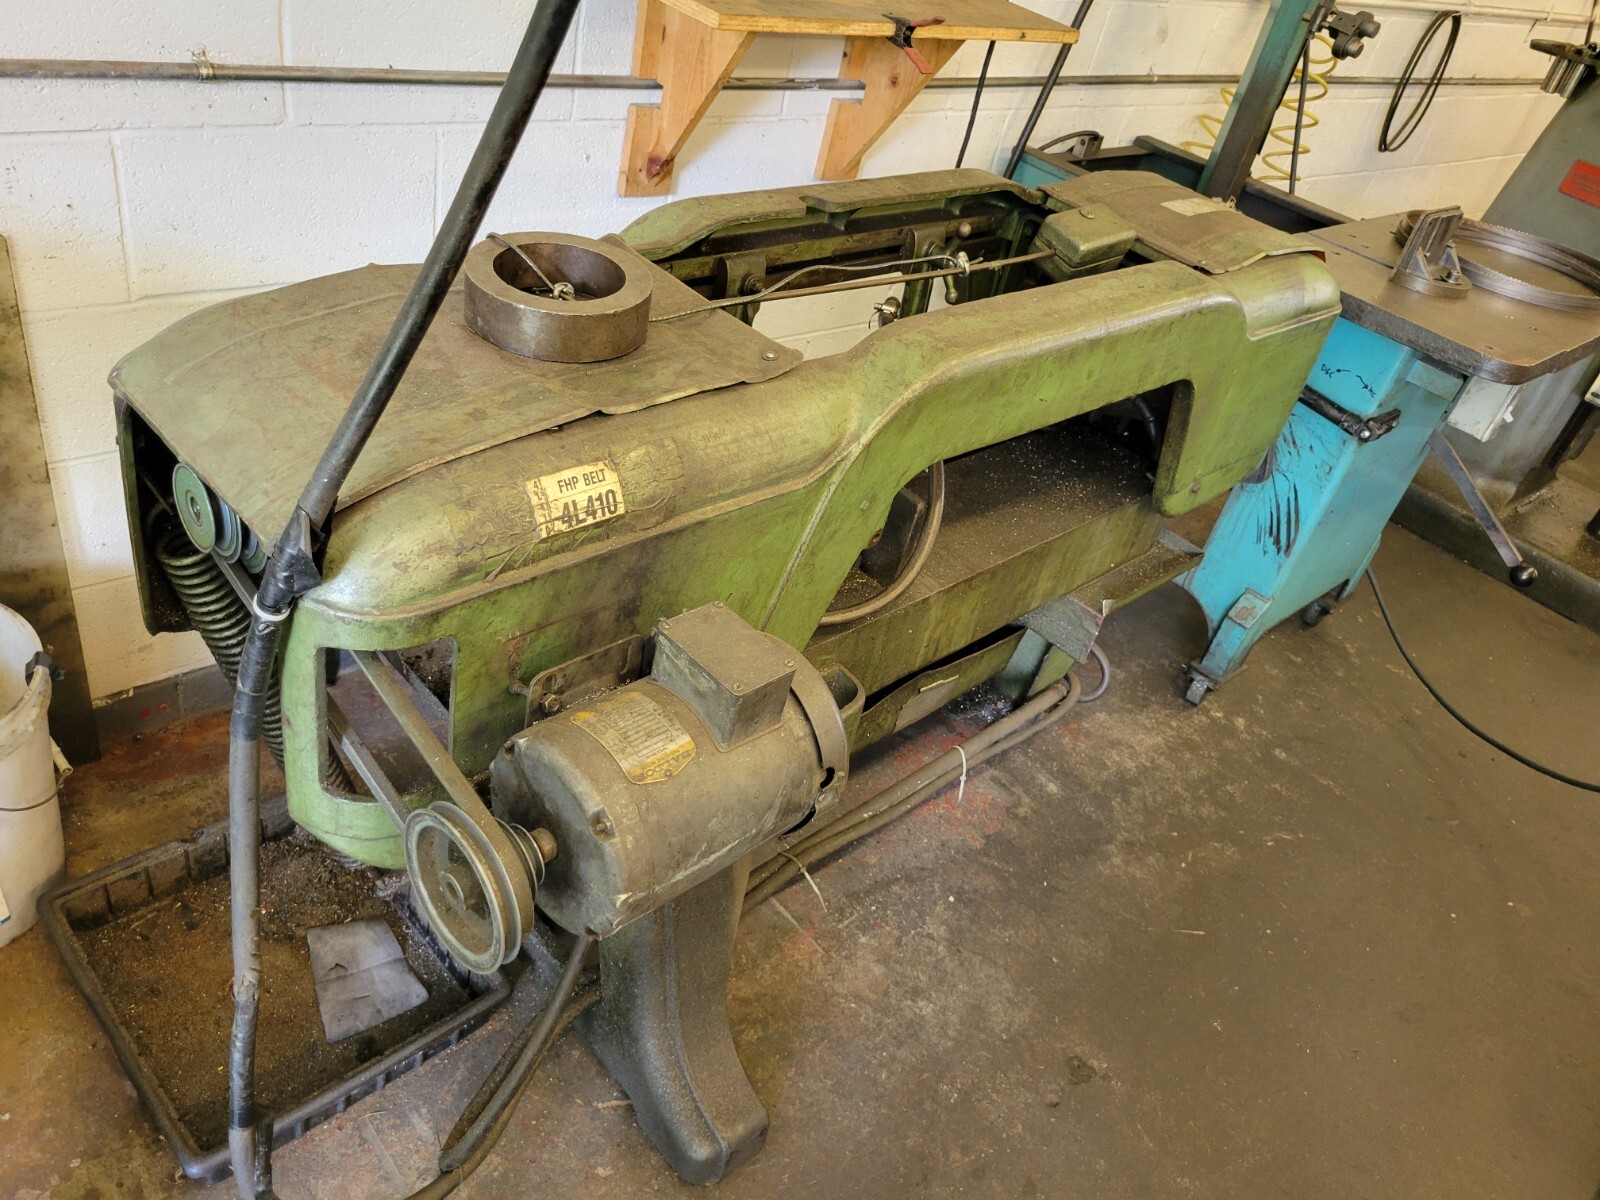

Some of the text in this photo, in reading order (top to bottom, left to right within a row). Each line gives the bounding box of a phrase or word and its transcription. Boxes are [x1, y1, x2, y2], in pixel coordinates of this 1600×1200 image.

[557, 468, 607, 494] FHP BELT
[560, 489, 619, 530] 4L410
